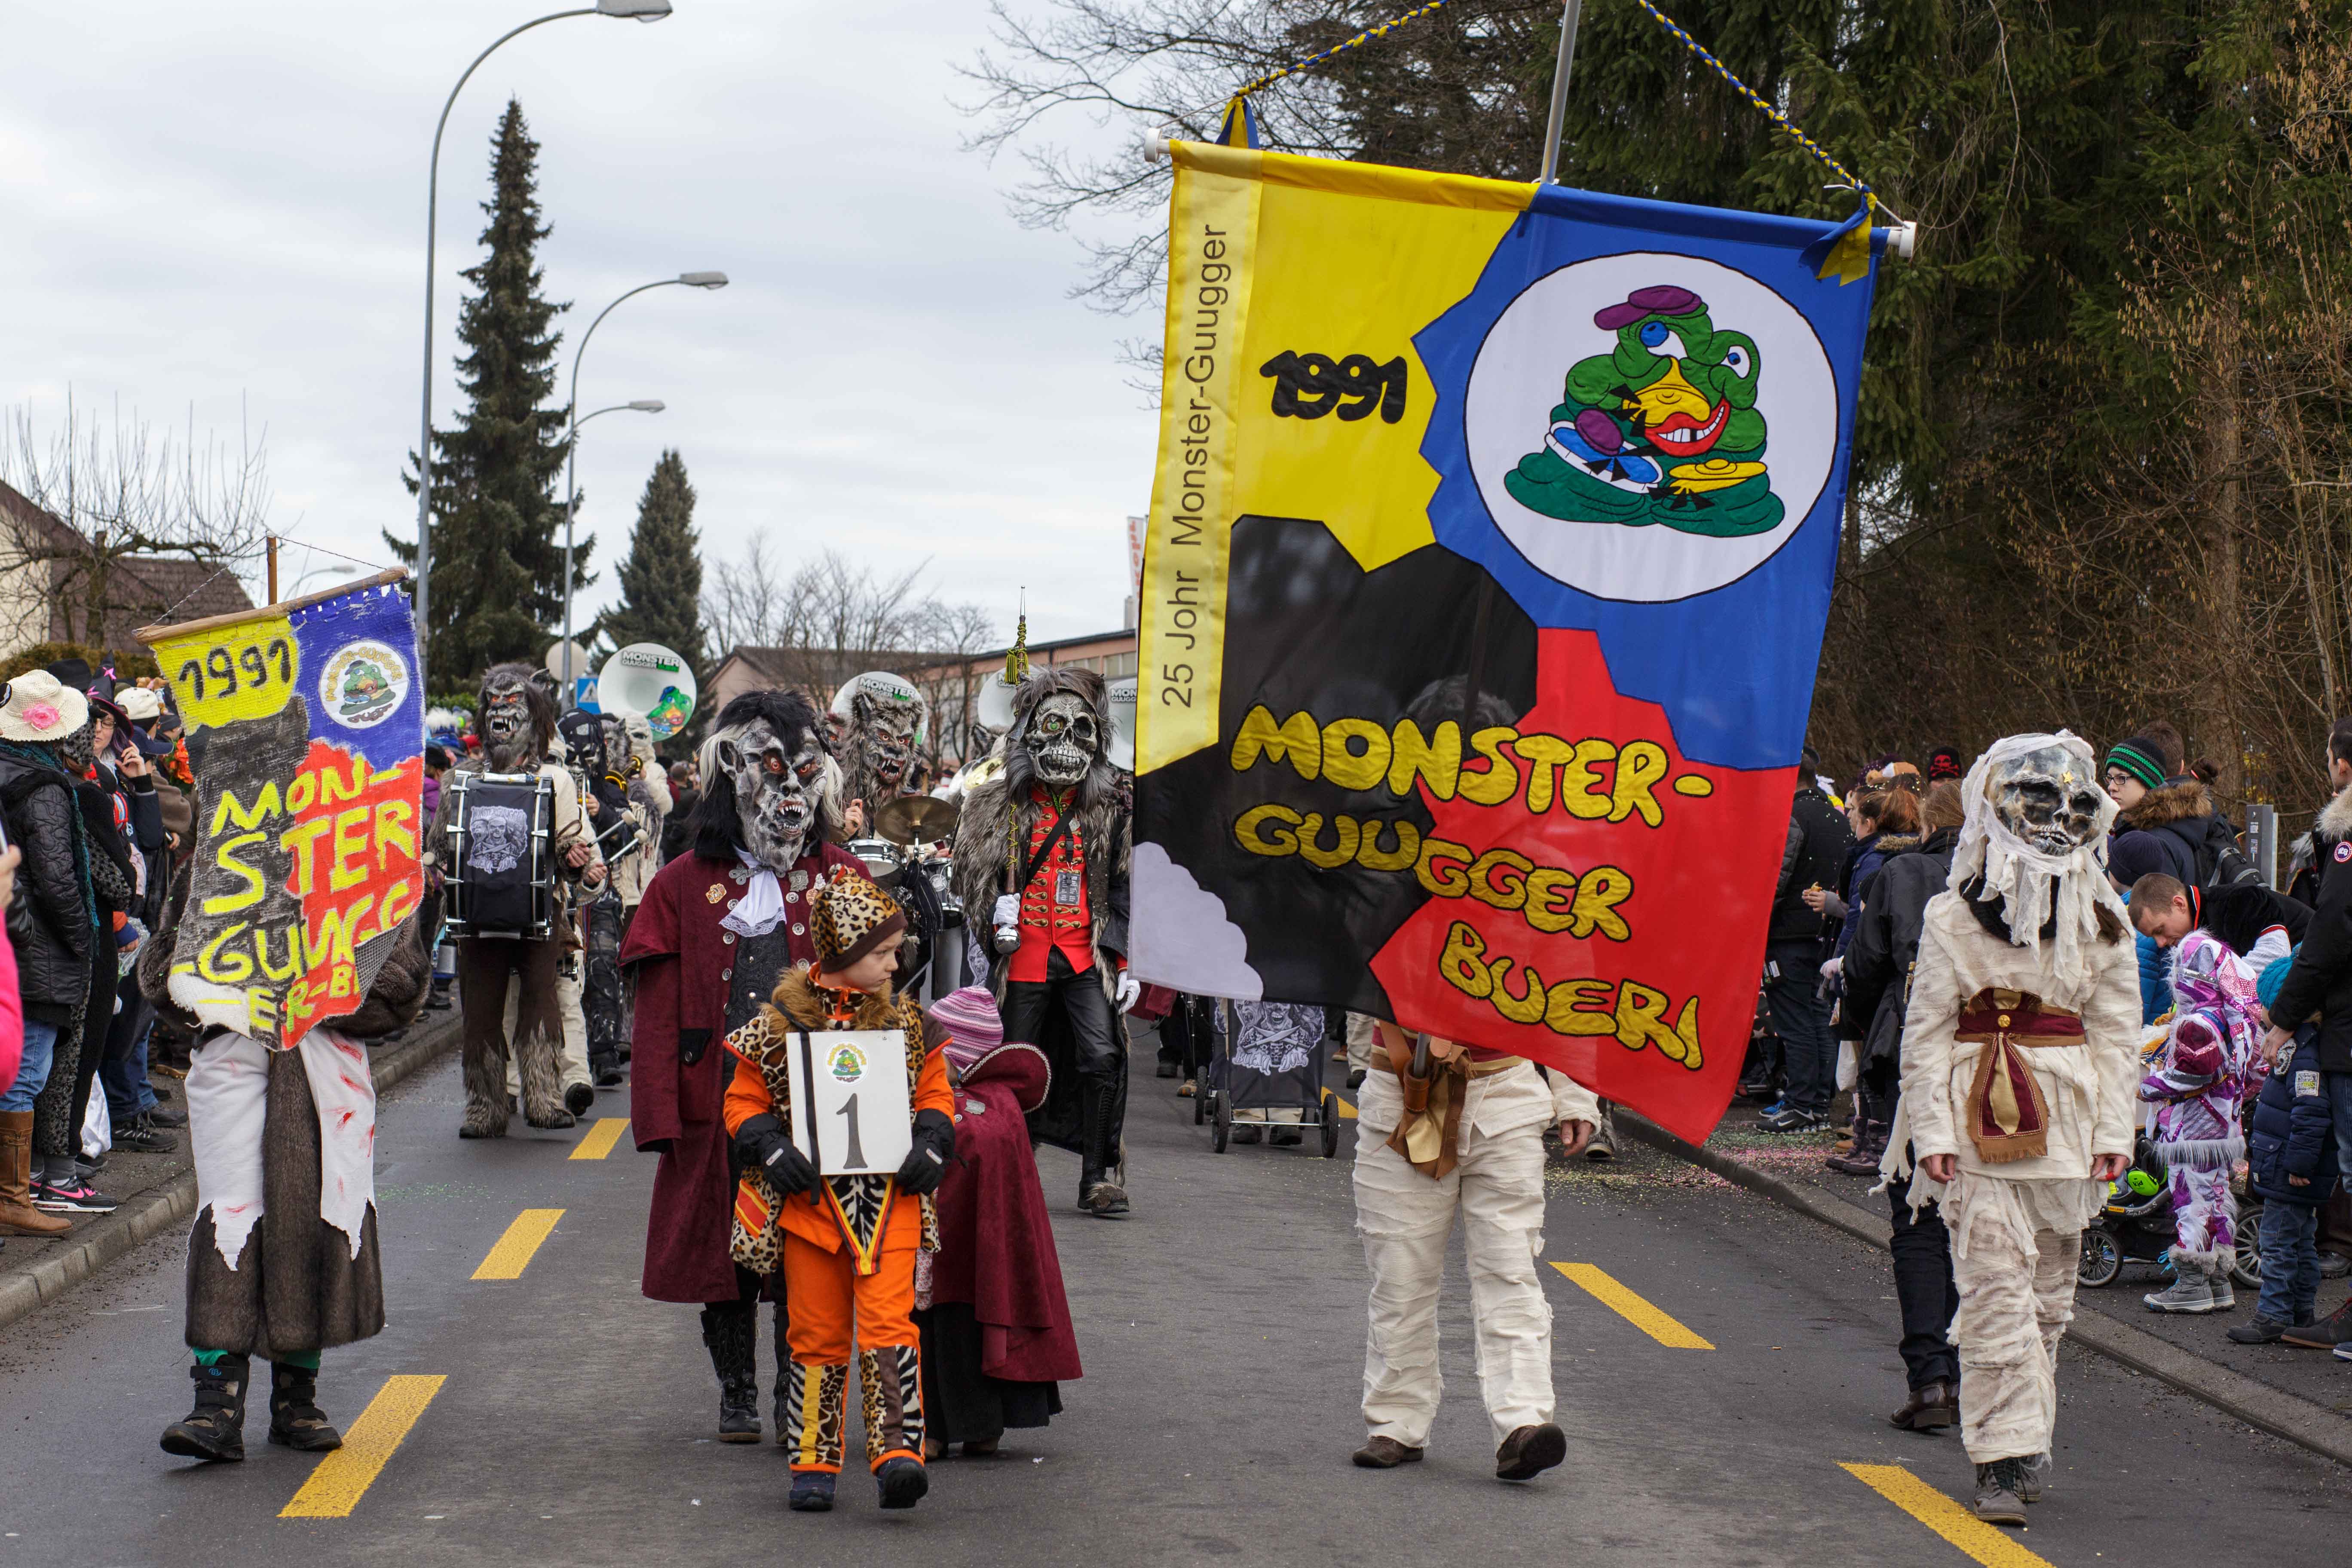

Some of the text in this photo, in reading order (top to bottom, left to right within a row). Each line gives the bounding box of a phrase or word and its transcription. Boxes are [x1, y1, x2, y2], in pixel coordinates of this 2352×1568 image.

[1259, 349, 1408, 424] 1991
[1162, 224, 1231, 708] 25 Johr Monster-Guugger
[178, 639, 291, 701] 1991
[622, 651, 680, 667] MONSTER
[860, 677, 915, 698] MONSTER
[210, 755, 404, 837] MON-
[1230, 704, 1714, 828] MONSTER-
[203, 801, 414, 914] STER
[1234, 803, 1633, 942] GUUGGER
[836, 1093, 868, 1169] 1
